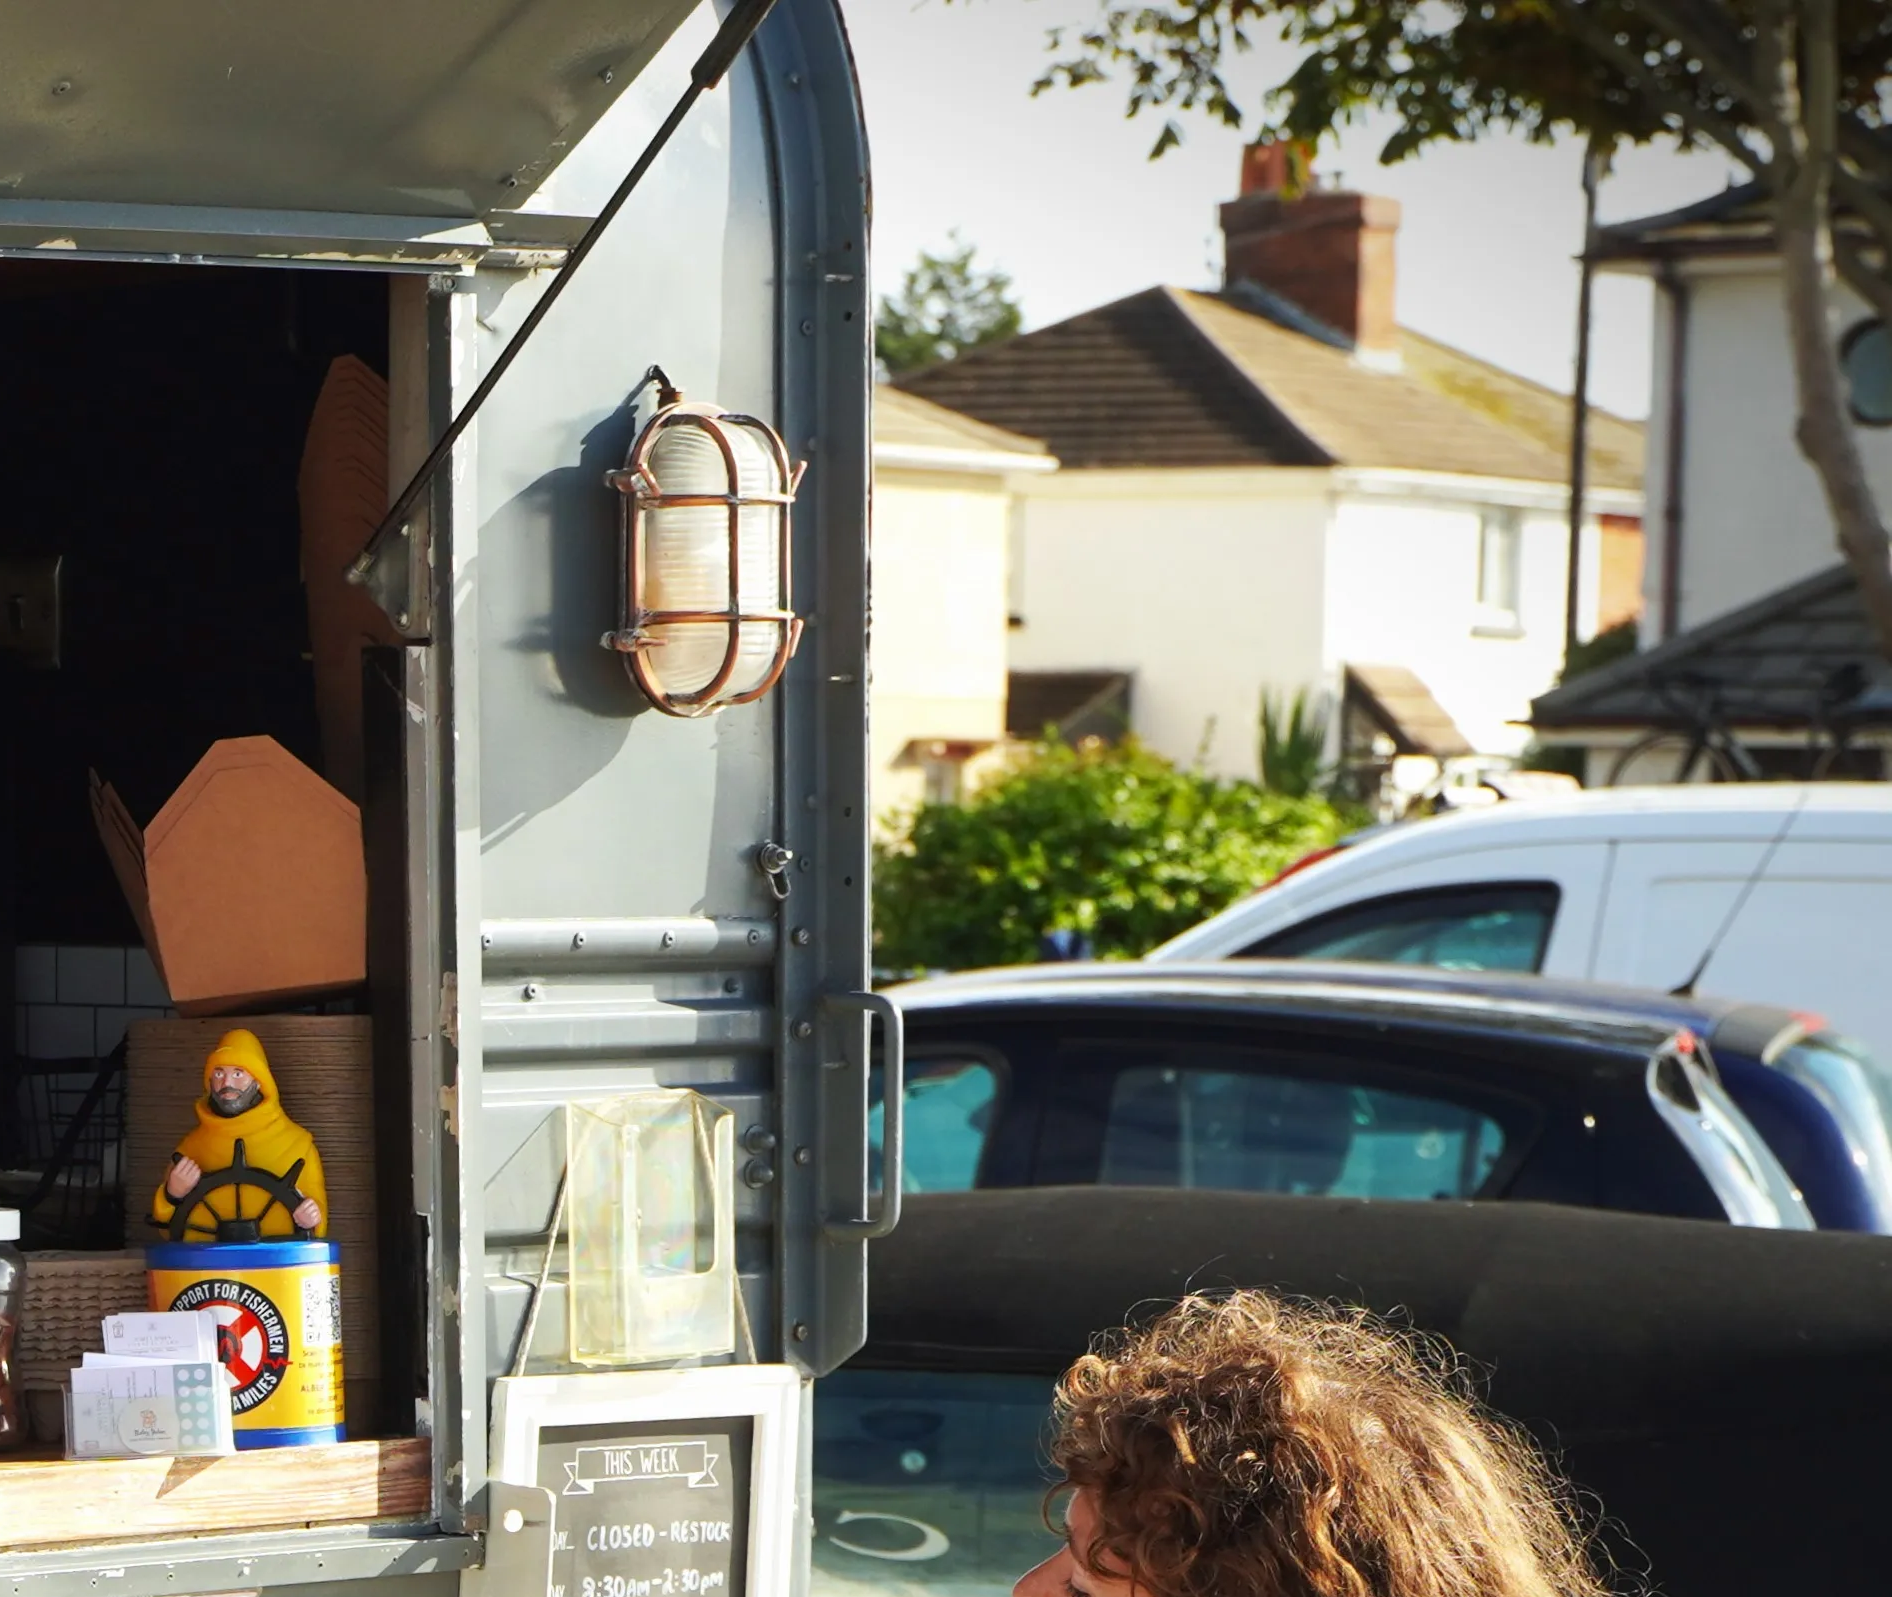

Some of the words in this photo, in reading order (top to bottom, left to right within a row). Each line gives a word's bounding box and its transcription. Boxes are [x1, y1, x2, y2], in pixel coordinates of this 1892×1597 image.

[215, 1283, 241, 1301] FOR
[240, 1289, 285, 1354] FISHERMEN
[232, 1371, 278, 1412] AMILIES
[604, 1450, 635, 1475] THIS
[639, 1446, 680, 1474] WEEK
[586, 1522, 655, 1551] CLOSED
[670, 1520, 732, 1543] RESTOCK
